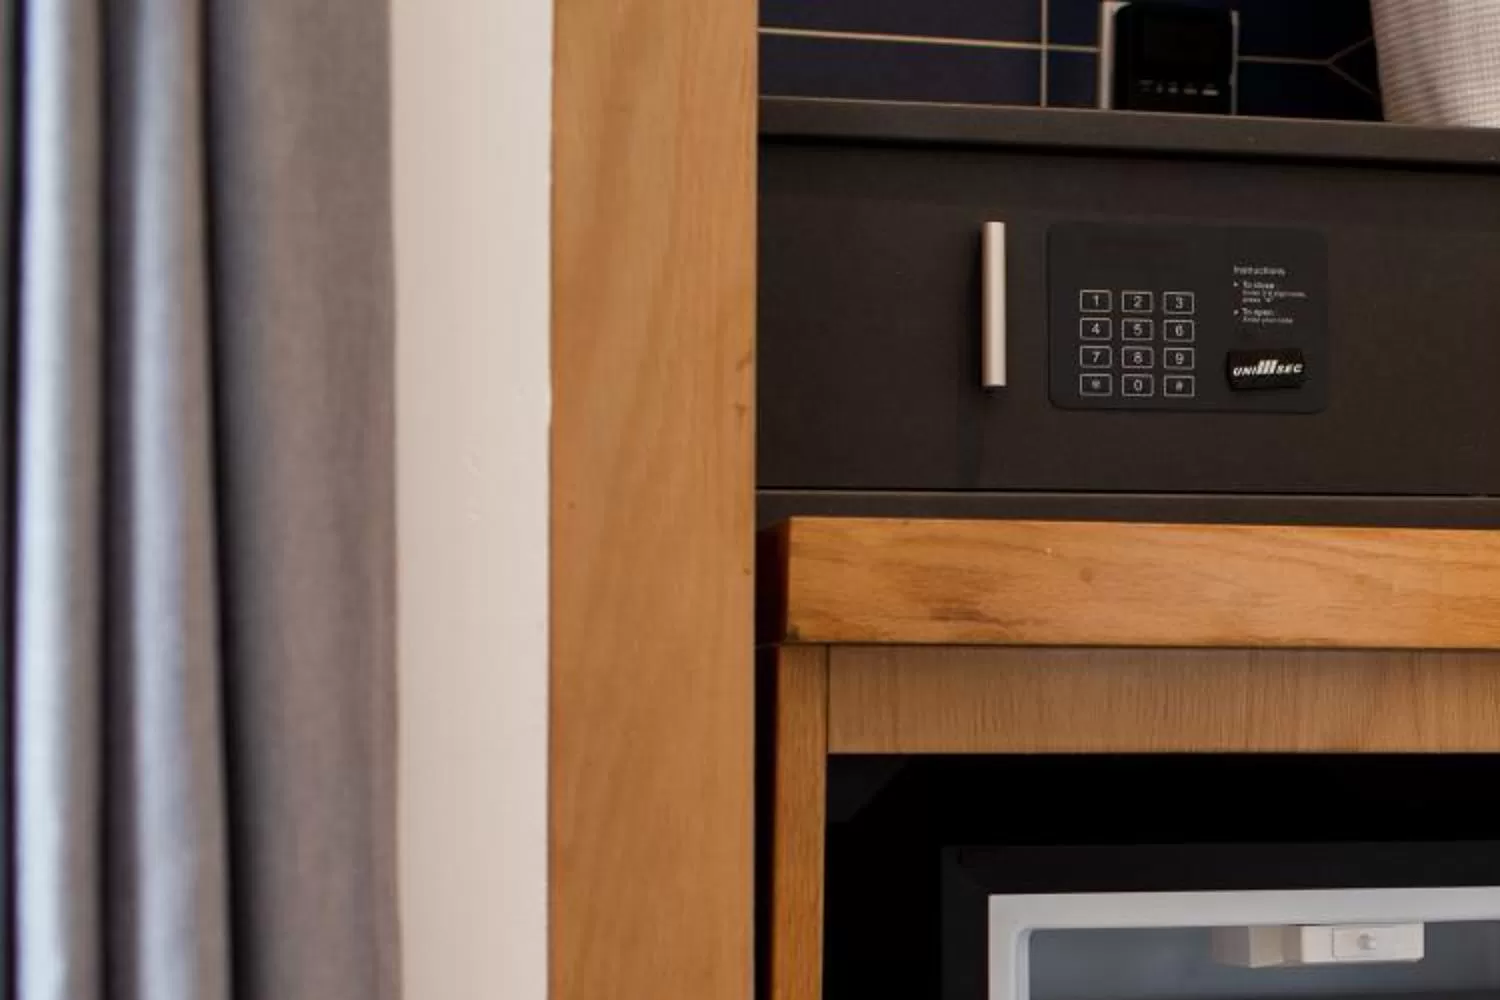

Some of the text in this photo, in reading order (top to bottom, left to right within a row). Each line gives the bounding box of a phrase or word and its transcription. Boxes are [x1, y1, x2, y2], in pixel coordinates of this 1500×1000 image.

[1133, 296, 1143, 308] 2
[1175, 297, 1184, 309] 3
[1091, 323, 1184, 337] 4 5 6
[1092, 351, 1185, 365] 7 8 9
